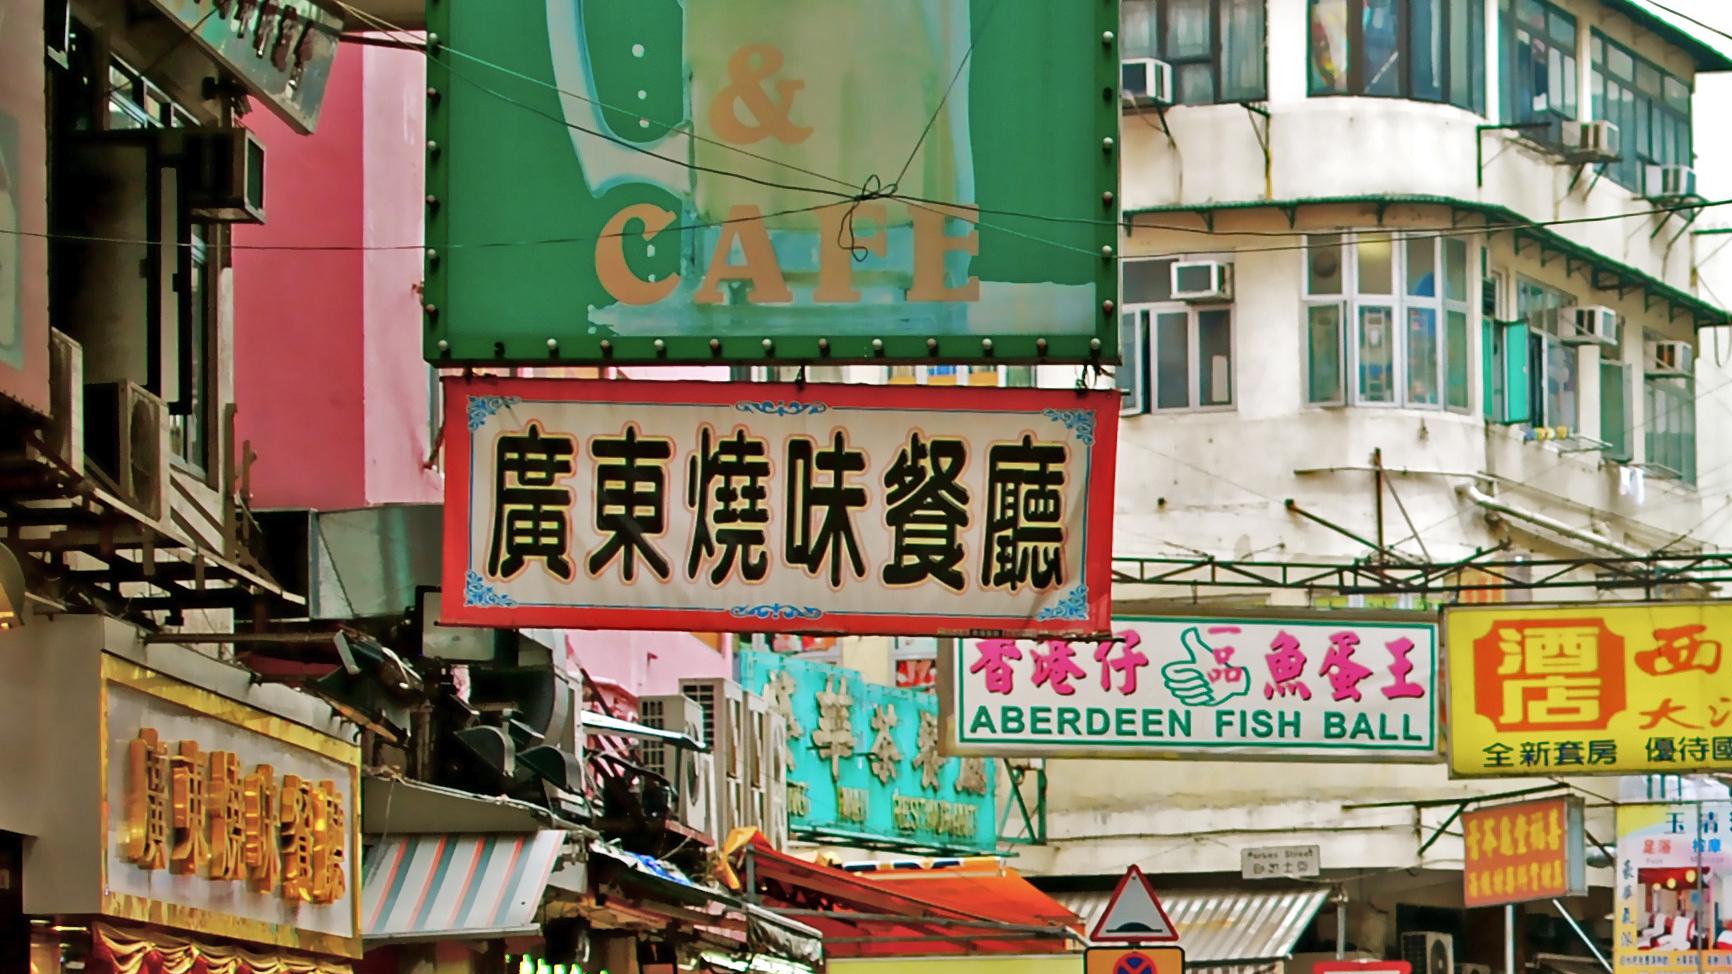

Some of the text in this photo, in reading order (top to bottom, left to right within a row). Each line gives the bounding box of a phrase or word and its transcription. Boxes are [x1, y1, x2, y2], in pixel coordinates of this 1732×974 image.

[707, 42, 814, 147] &
[594, 202, 981, 306] CAFE
[486, 420, 1069, 591] 廣東燒味餐廳
[970, 628, 1149, 696] 香港仔
[1263, 630, 1426, 701] 魚蛋王
[1496, 627, 1601, 725] 酒店
[970, 706, 1424, 742] ABERDEEN FISH BALL
[1482, 738, 1618, 769] 全新套房
